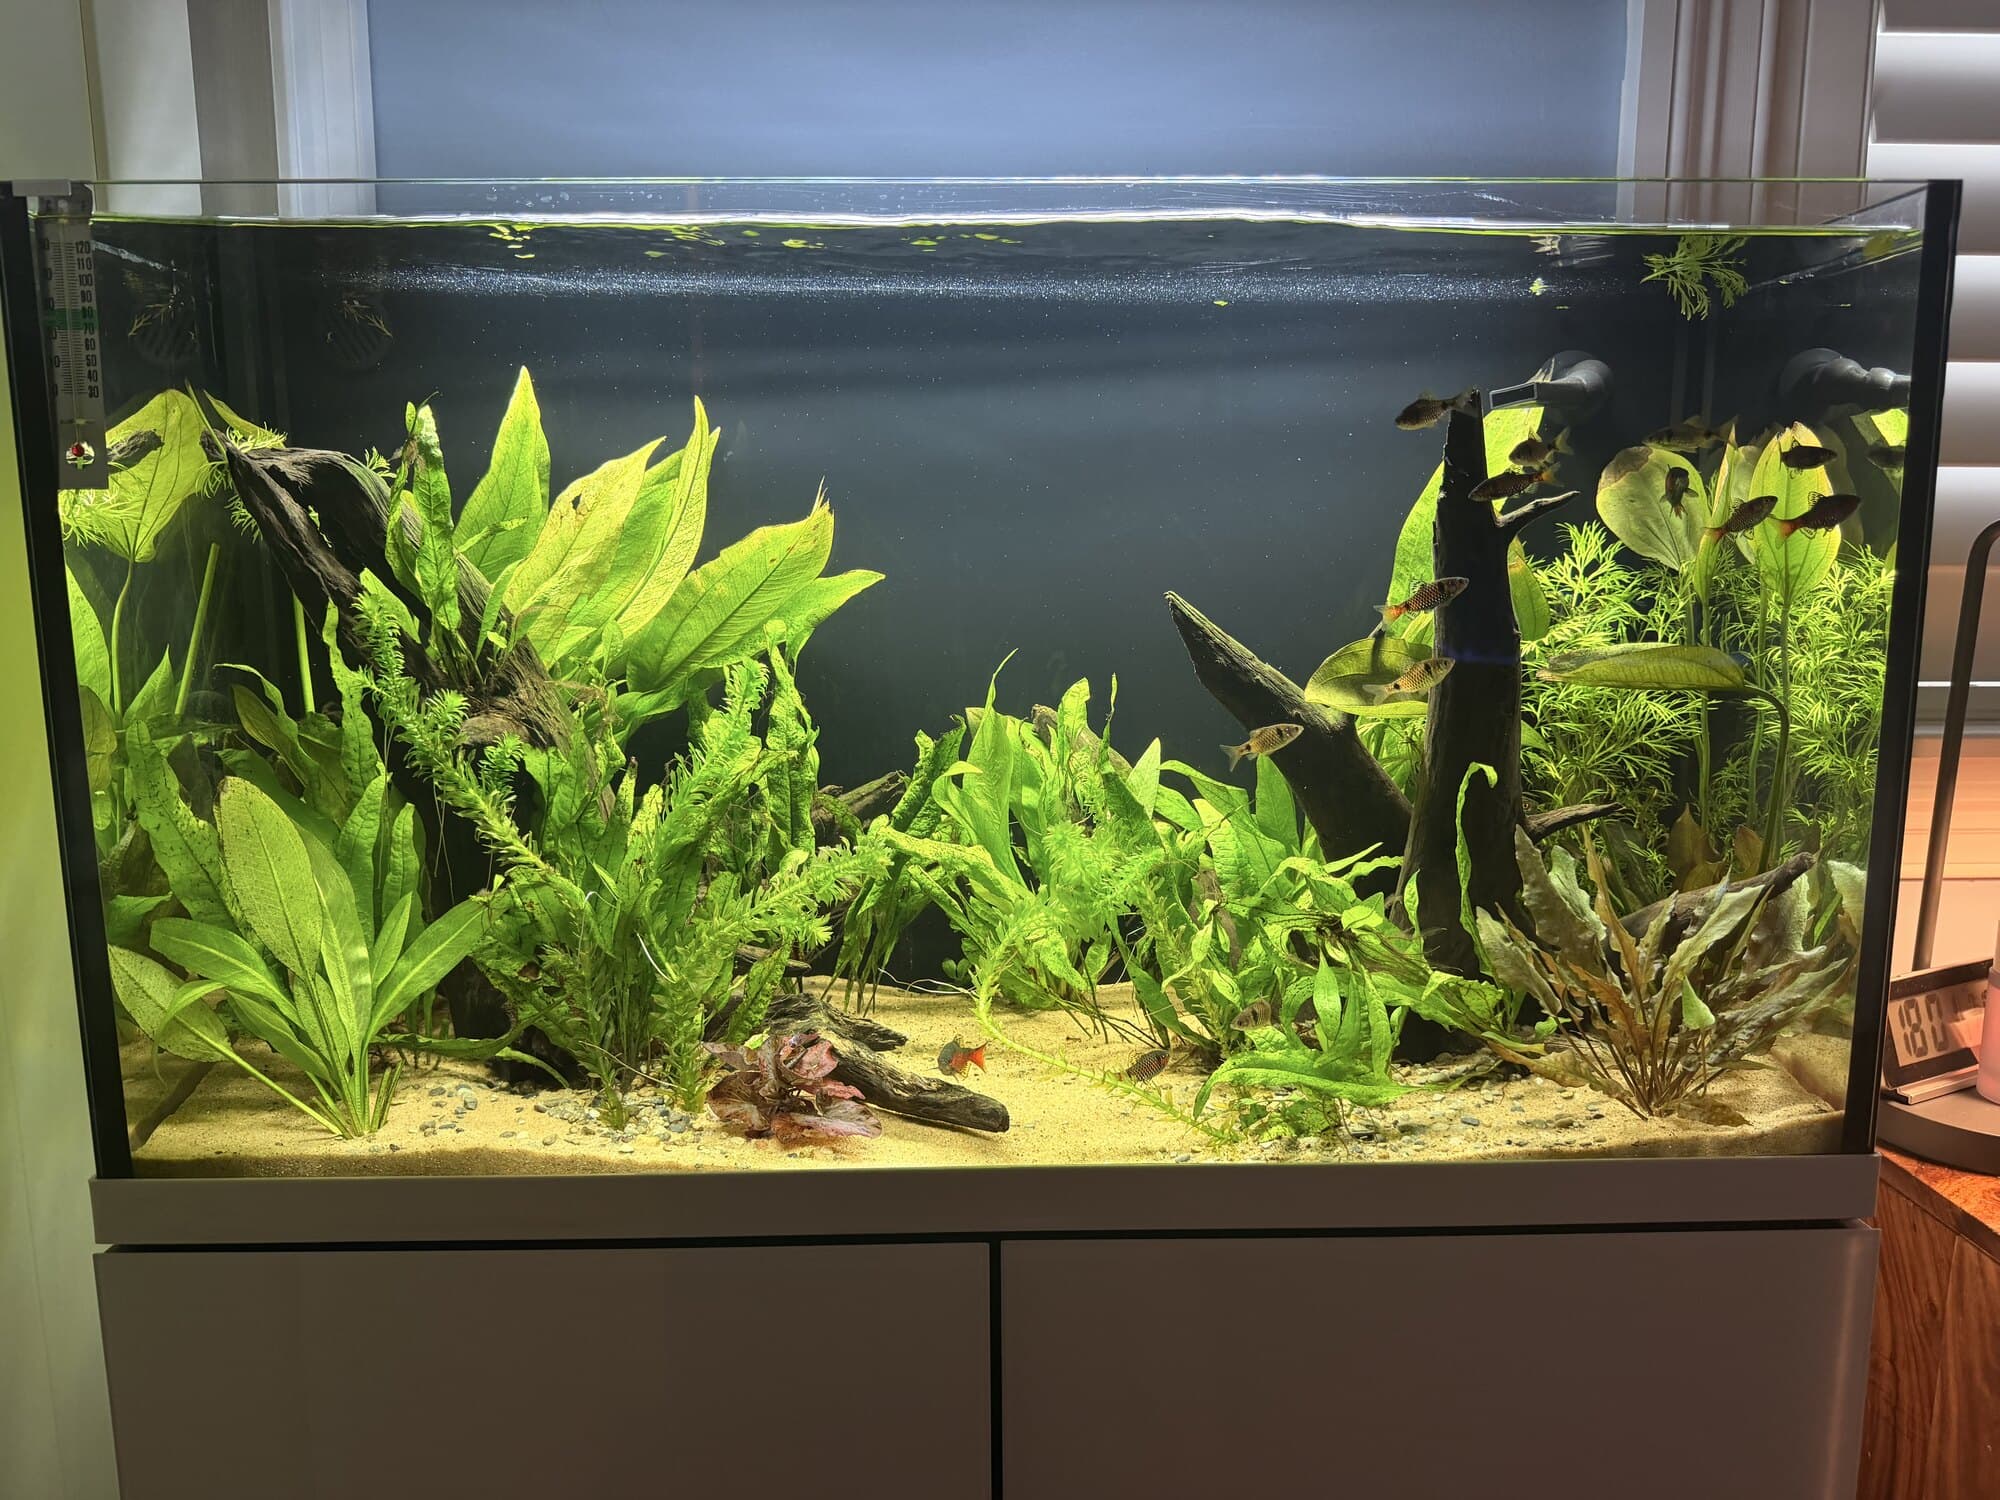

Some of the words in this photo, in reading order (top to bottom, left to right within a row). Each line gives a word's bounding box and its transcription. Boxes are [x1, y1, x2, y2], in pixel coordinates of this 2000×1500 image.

[75, 241, 91, 254] 120
[77, 257, 93, 270] 110
[79, 273, 93, 286] 100
[83, 322, 95, 335] 70
[85, 338, 96, 351] 60
[86, 354, 97, 367] 50
[88, 370, 99, 382] 40
[88, 386, 100, 399] 30
